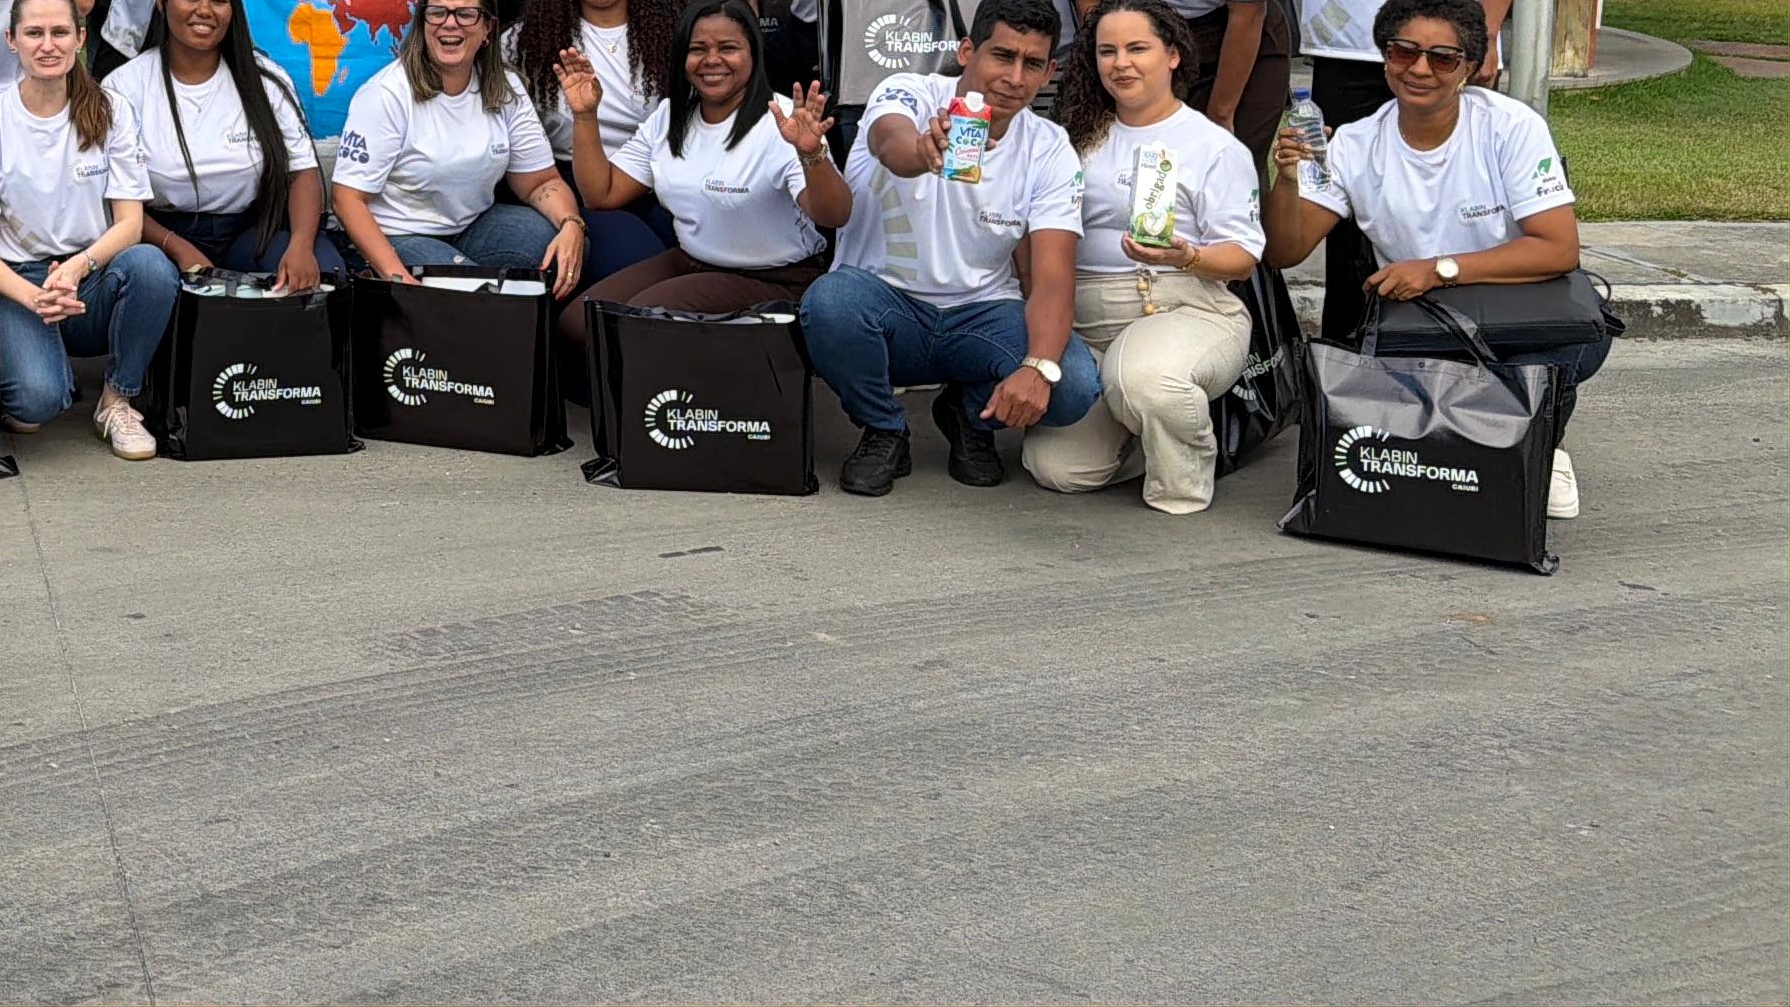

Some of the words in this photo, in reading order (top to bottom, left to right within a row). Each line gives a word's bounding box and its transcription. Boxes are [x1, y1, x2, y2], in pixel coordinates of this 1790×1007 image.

[886, 31, 933, 44] KLABIN
[886, 41, 960, 53] TRANSFOR
[960, 126, 982, 139] VITA
[344, 130, 368, 151] VITA
[705, 184, 750, 194] TRANSFORMA
[403, 365, 448, 381] KLABIN
[233, 378, 278, 392] KLABIN
[403, 376, 495, 398] TRANSFORMA
[232, 386, 322, 402] TRANSFORMA
[667, 409, 718, 422] KLABIN
[667, 419, 771, 433] TRANSFORMA
[1359, 446, 1418, 466] KLABIN
[1360, 458, 1479, 484] TRANSFORMA
[1451, 483, 1479, 492] CAIUBI
